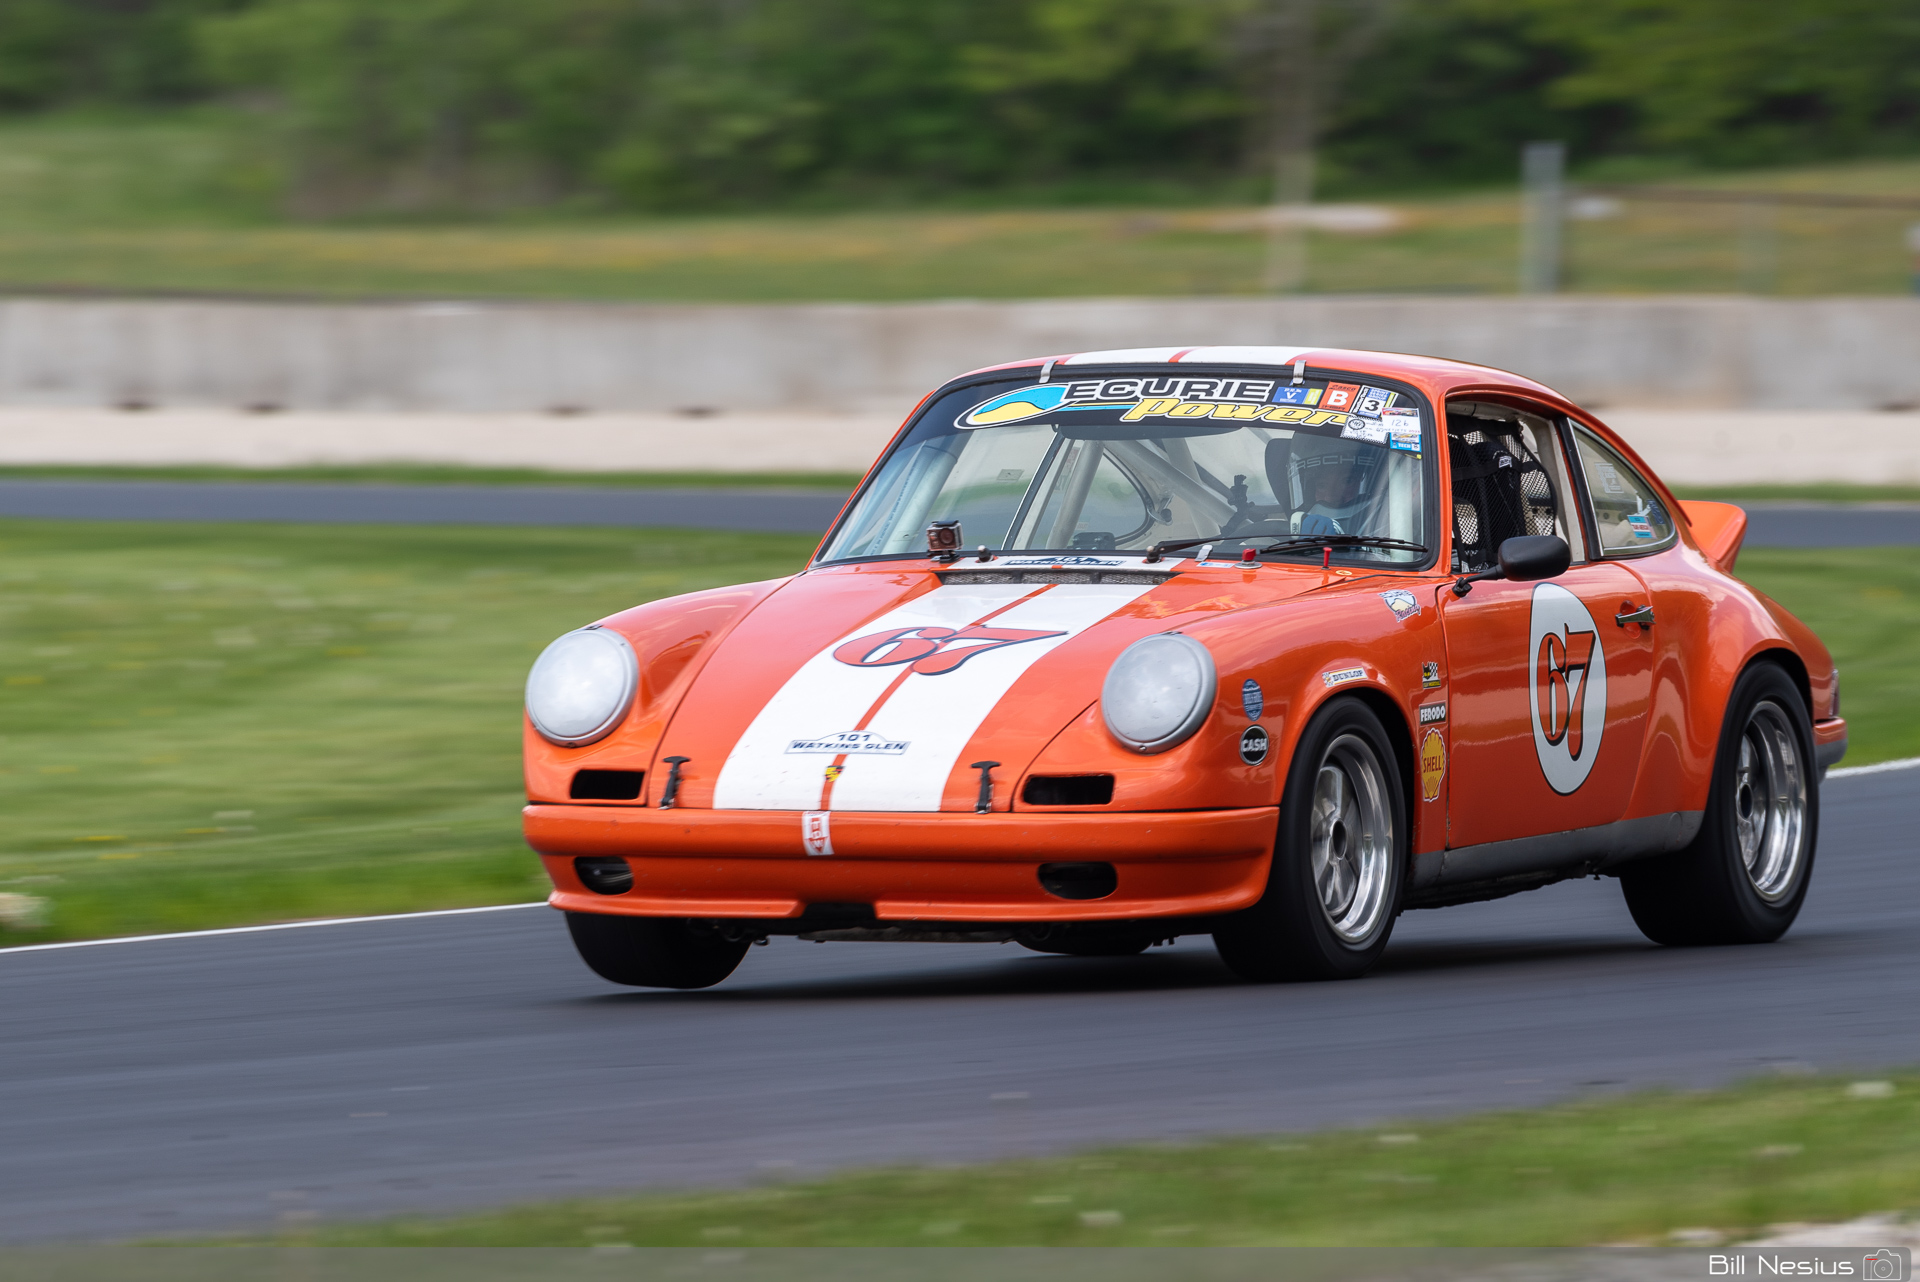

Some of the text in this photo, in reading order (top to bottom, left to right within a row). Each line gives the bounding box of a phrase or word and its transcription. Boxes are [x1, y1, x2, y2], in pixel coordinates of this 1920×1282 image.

[1063, 379, 1274, 401] ECURIE
[1327, 390, 1349, 407] B
[1364, 400, 1380, 411] 3
[833, 624, 1068, 676] 67
[1332, 669, 1364, 682] DUNLOP
[1537, 623, 1596, 761] 67
[1420, 705, 1446, 722] FERODO
[1242, 738, 1267, 752] CASH
[1423, 755, 1442, 773] SHELL
